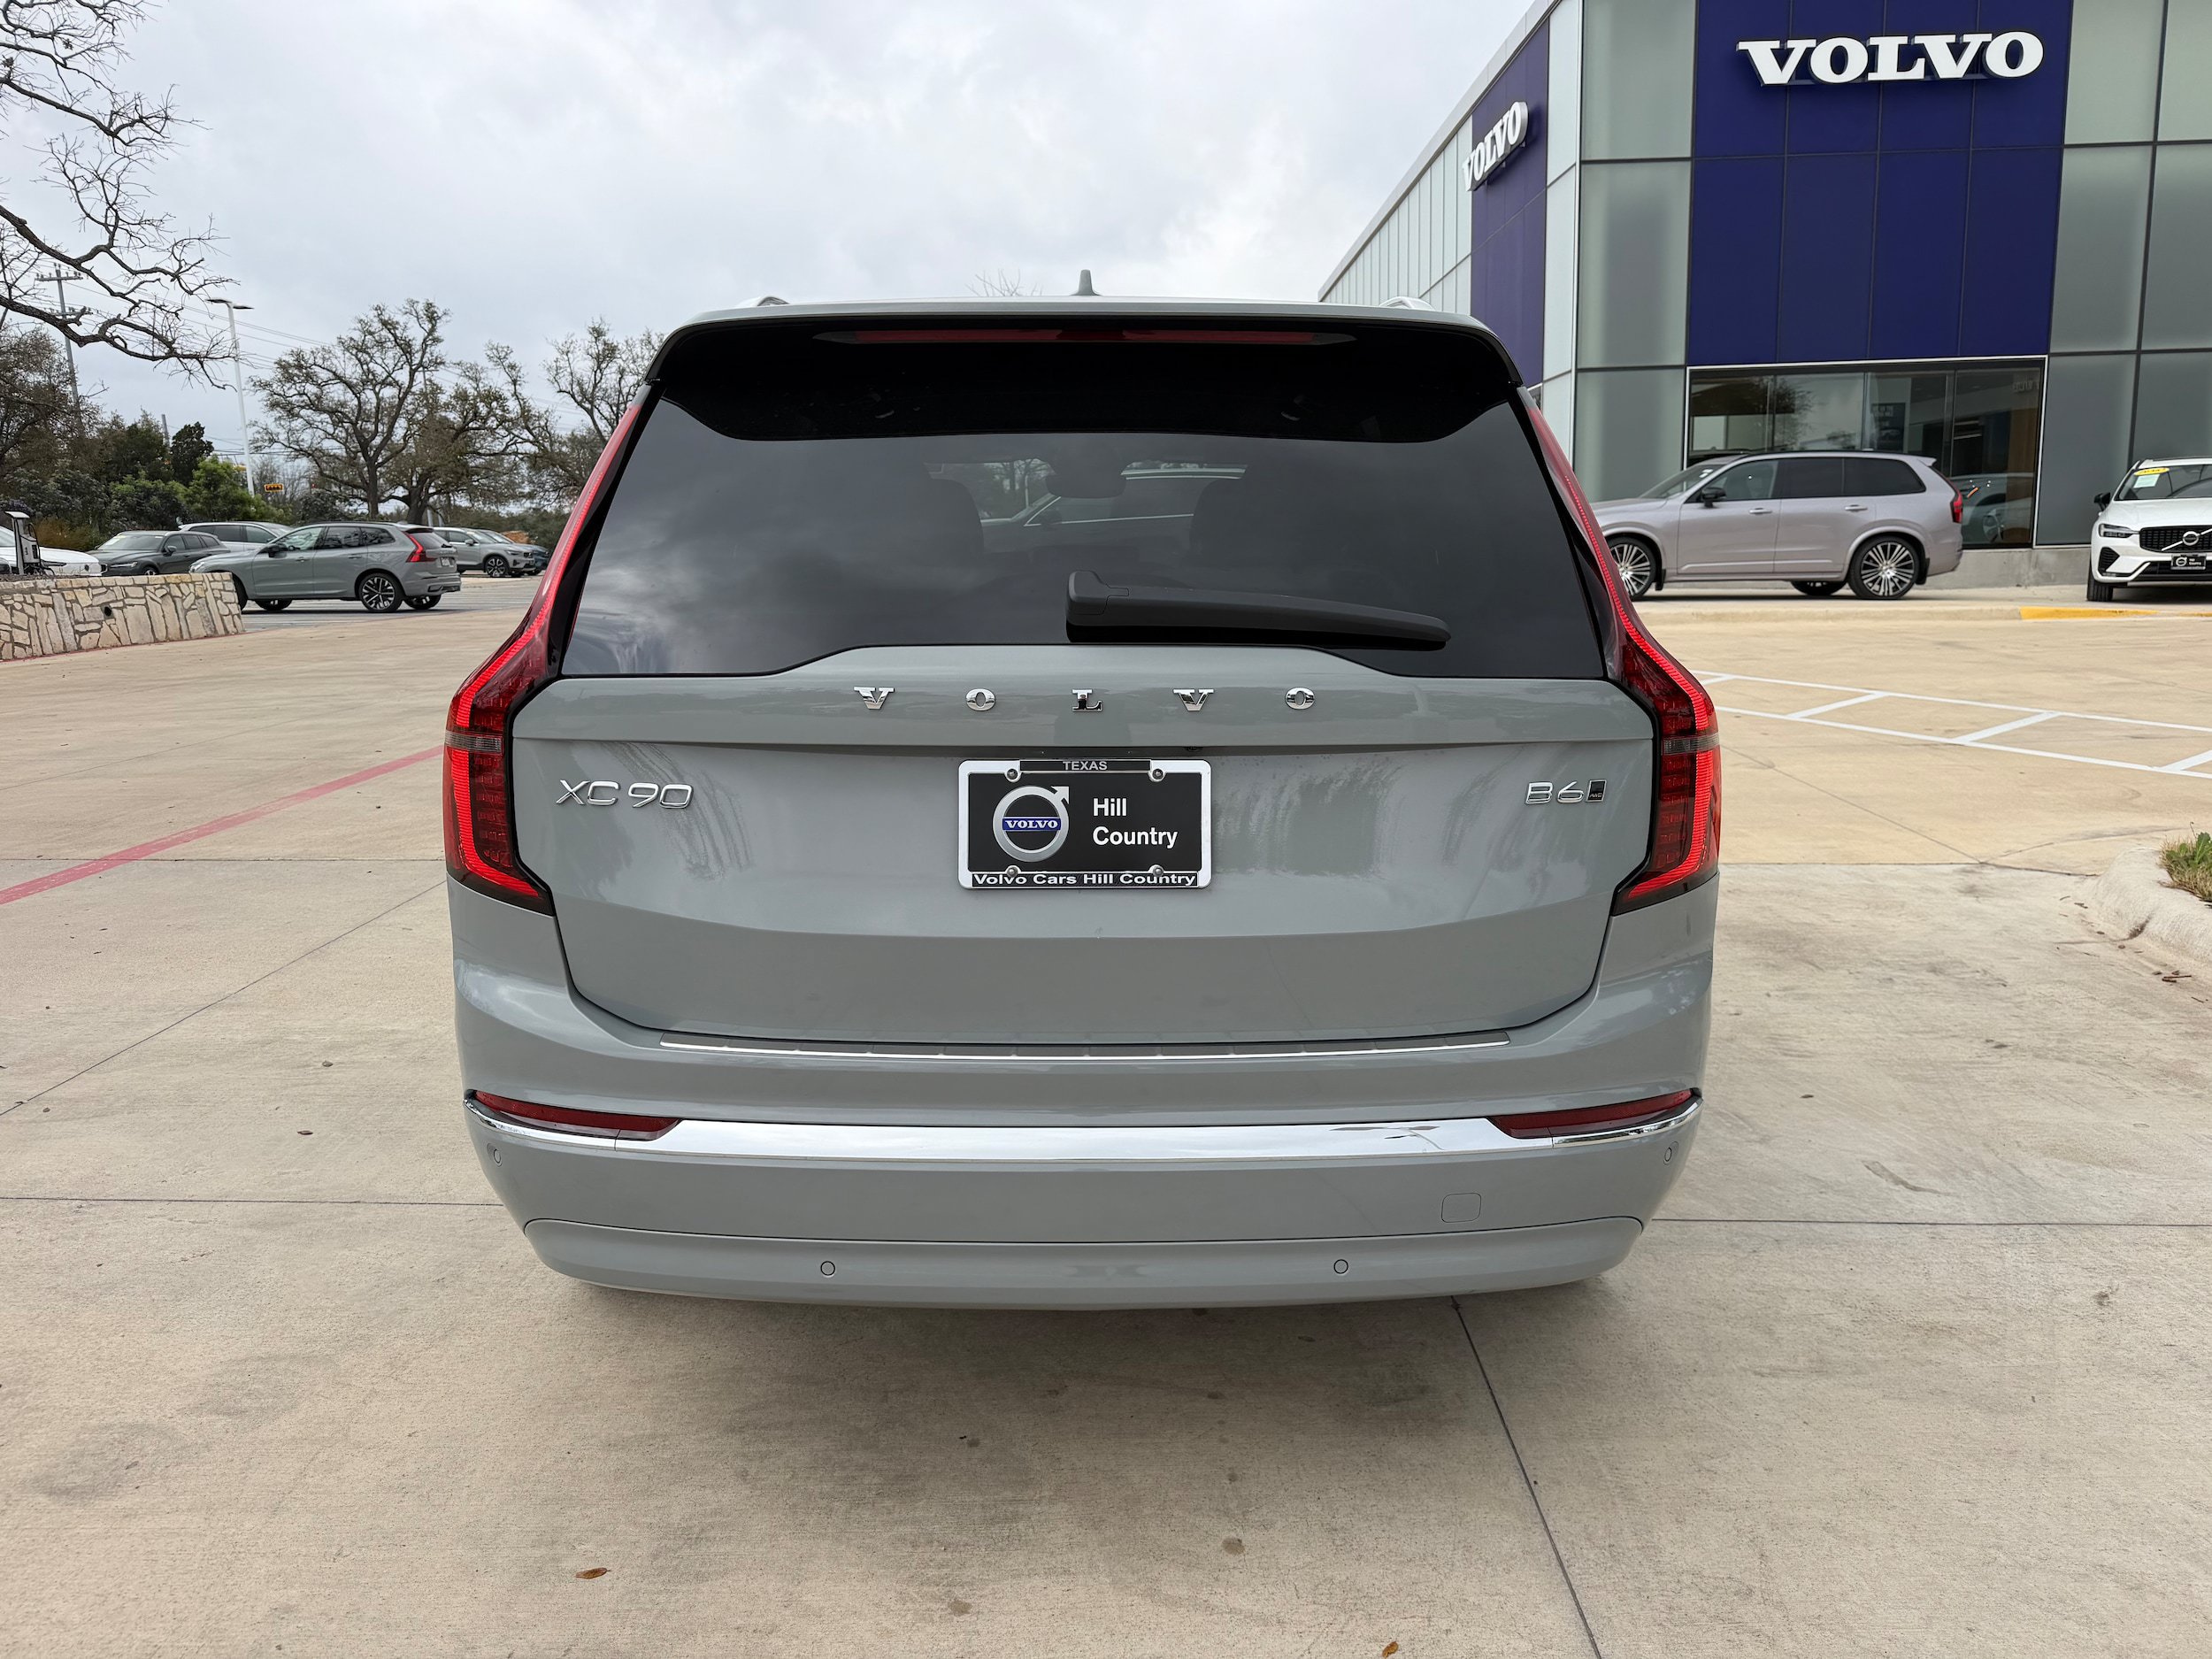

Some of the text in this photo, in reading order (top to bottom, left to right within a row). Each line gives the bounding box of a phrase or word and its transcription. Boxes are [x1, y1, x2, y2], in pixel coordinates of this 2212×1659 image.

[1737, 31, 2044, 86] VOLVO
[1462, 101, 1528, 192] VOLVO
[853, 686, 1316, 712] VOLVO
[1062, 760, 1108, 771] TEXAS
[1525, 781, 1584, 804] B6
[1093, 798, 1127, 817] Hill
[1005, 819, 1058, 829] VOLVO
[1093, 826, 1178, 849] Country
[973, 873, 1196, 887] Volvo Cars Hill Country
